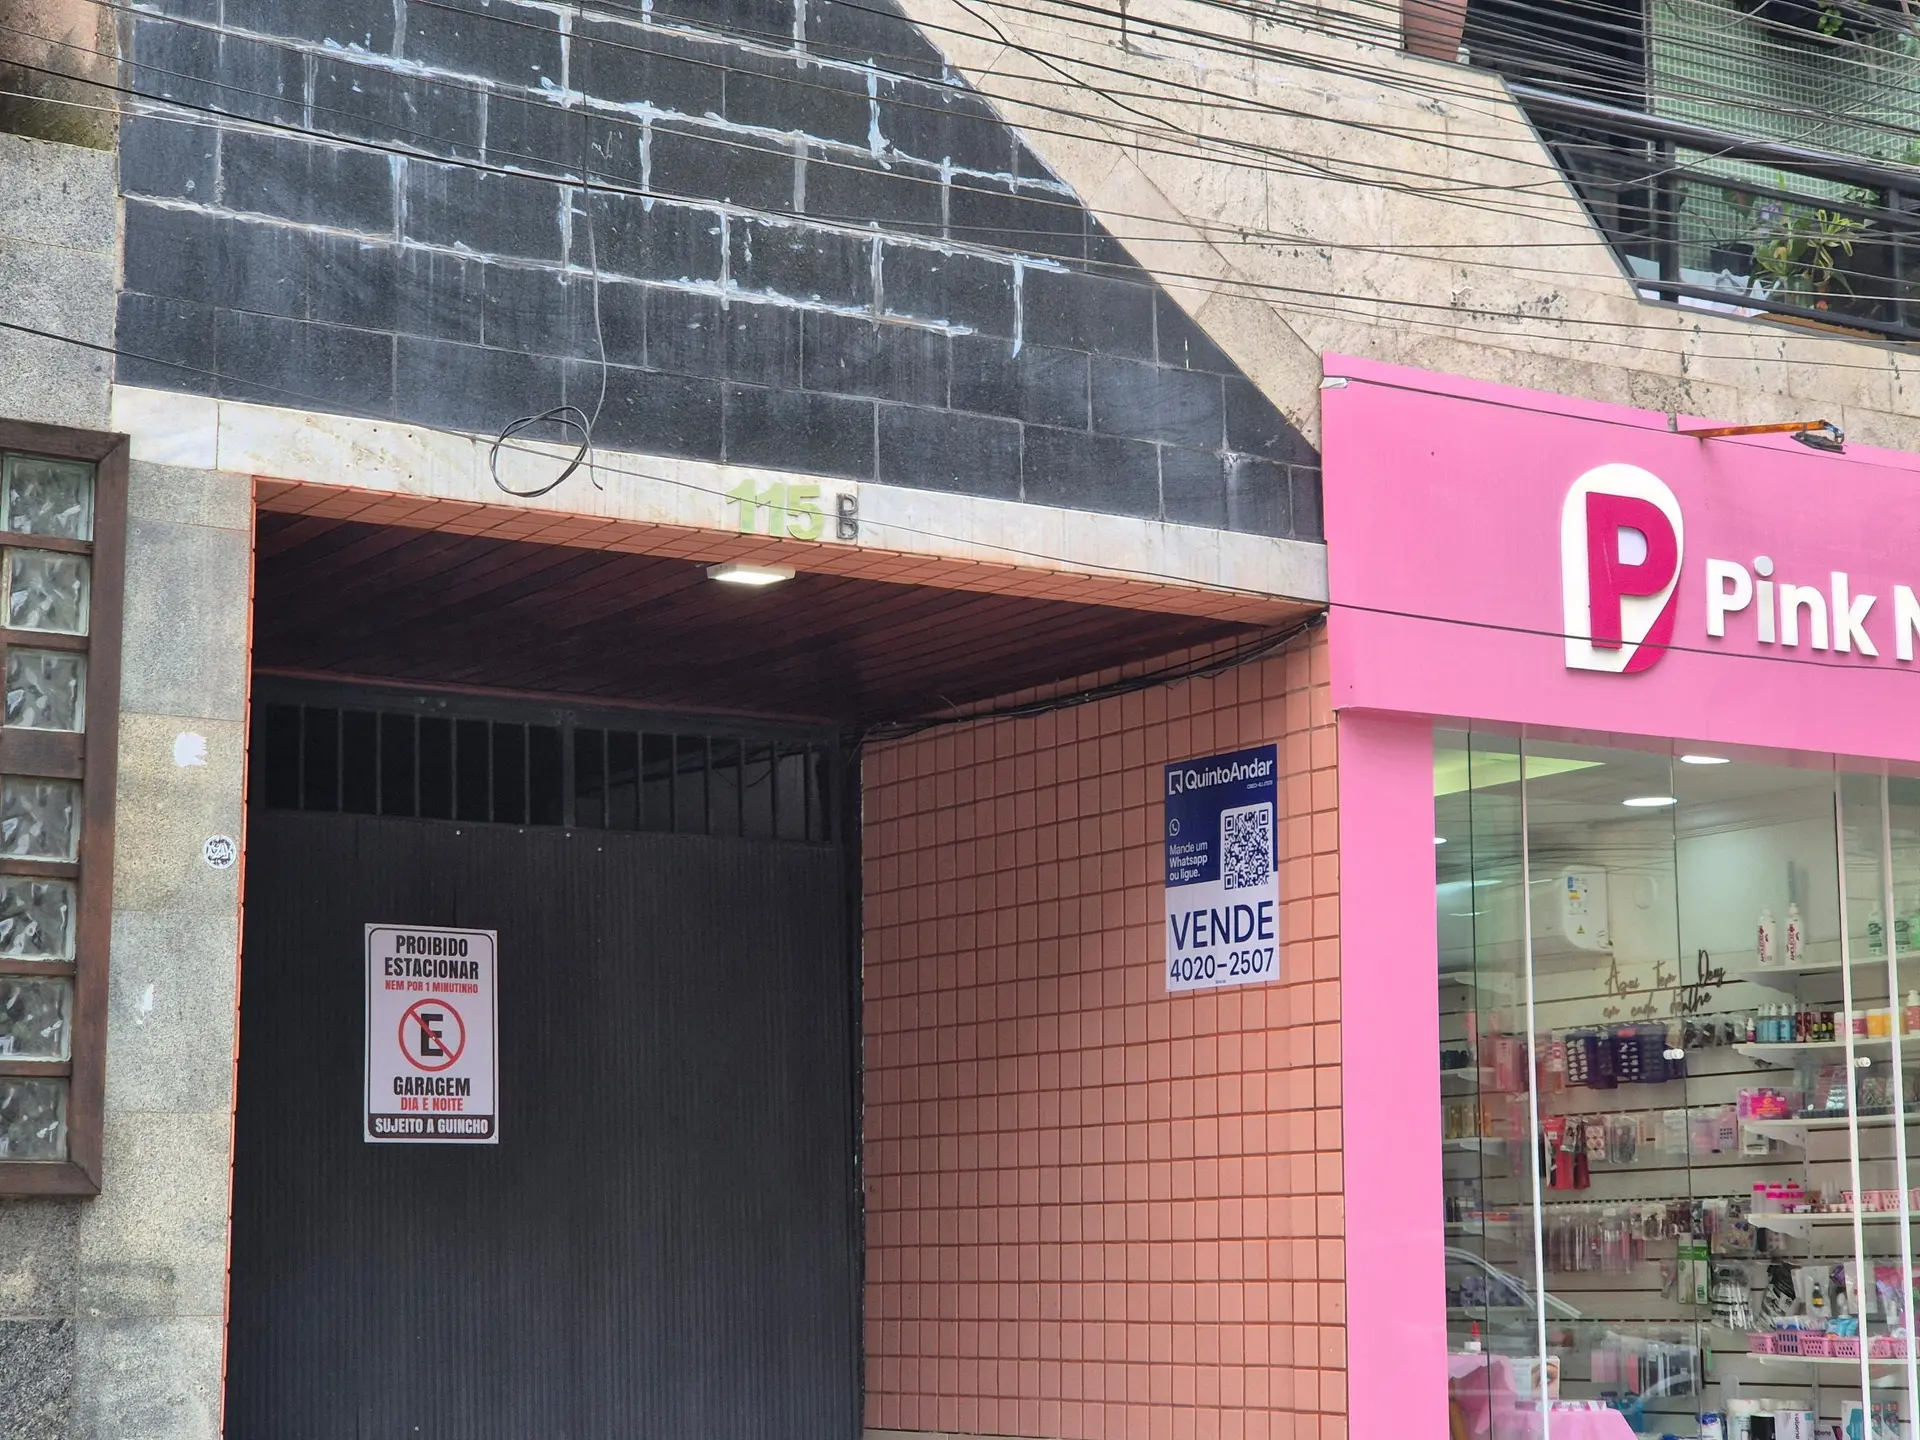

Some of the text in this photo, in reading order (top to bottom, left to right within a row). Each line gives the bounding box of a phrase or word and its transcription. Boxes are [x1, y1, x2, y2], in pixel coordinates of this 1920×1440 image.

[725, 479, 860, 540] 115 B
[1706, 556, 1880, 657] Pink
[1185, 758, 1273, 790] QuintoAndar
[1170, 841, 1208, 855] Mande um
[1169, 854, 1208, 868] Whatsapp
[1170, 868, 1200, 881] ou ligue.
[1170, 900, 1274, 950] VENDE
[396, 935, 468, 957] PROIBIDO
[384, 957, 479, 980] ESTACIONAR
[1170, 948, 1274, 982] 4020-2507
[385, 980, 478, 994] NEM POR 1 MINUTINHO
[420, 1013, 443, 1057] E
[393, 1076, 470, 1096] GARAGEM
[401, 1097, 463, 1111] DIA E NOITE
[375, 1117, 489, 1134] SUJEITO A GUINCHO
